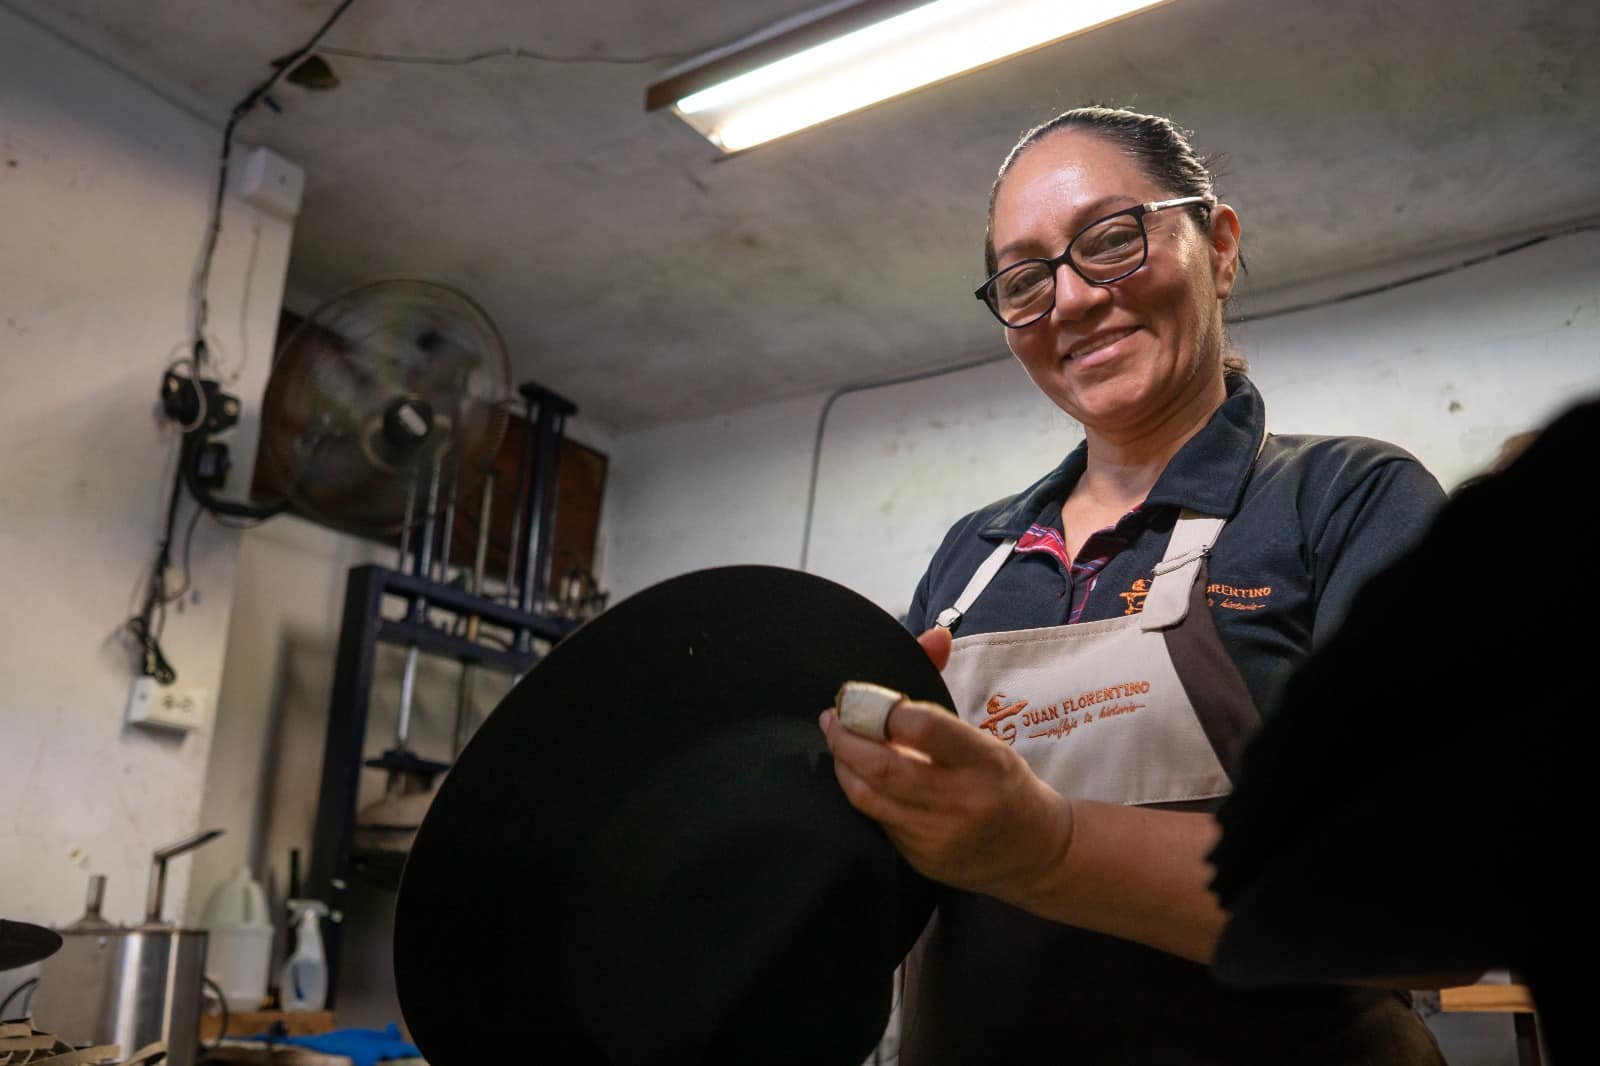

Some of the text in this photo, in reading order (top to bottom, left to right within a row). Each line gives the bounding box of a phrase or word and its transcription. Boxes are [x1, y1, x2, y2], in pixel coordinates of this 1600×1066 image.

[1207, 583, 1272, 599] RENTINO
[1022, 681, 1150, 727] JUAN FLORENTINO
